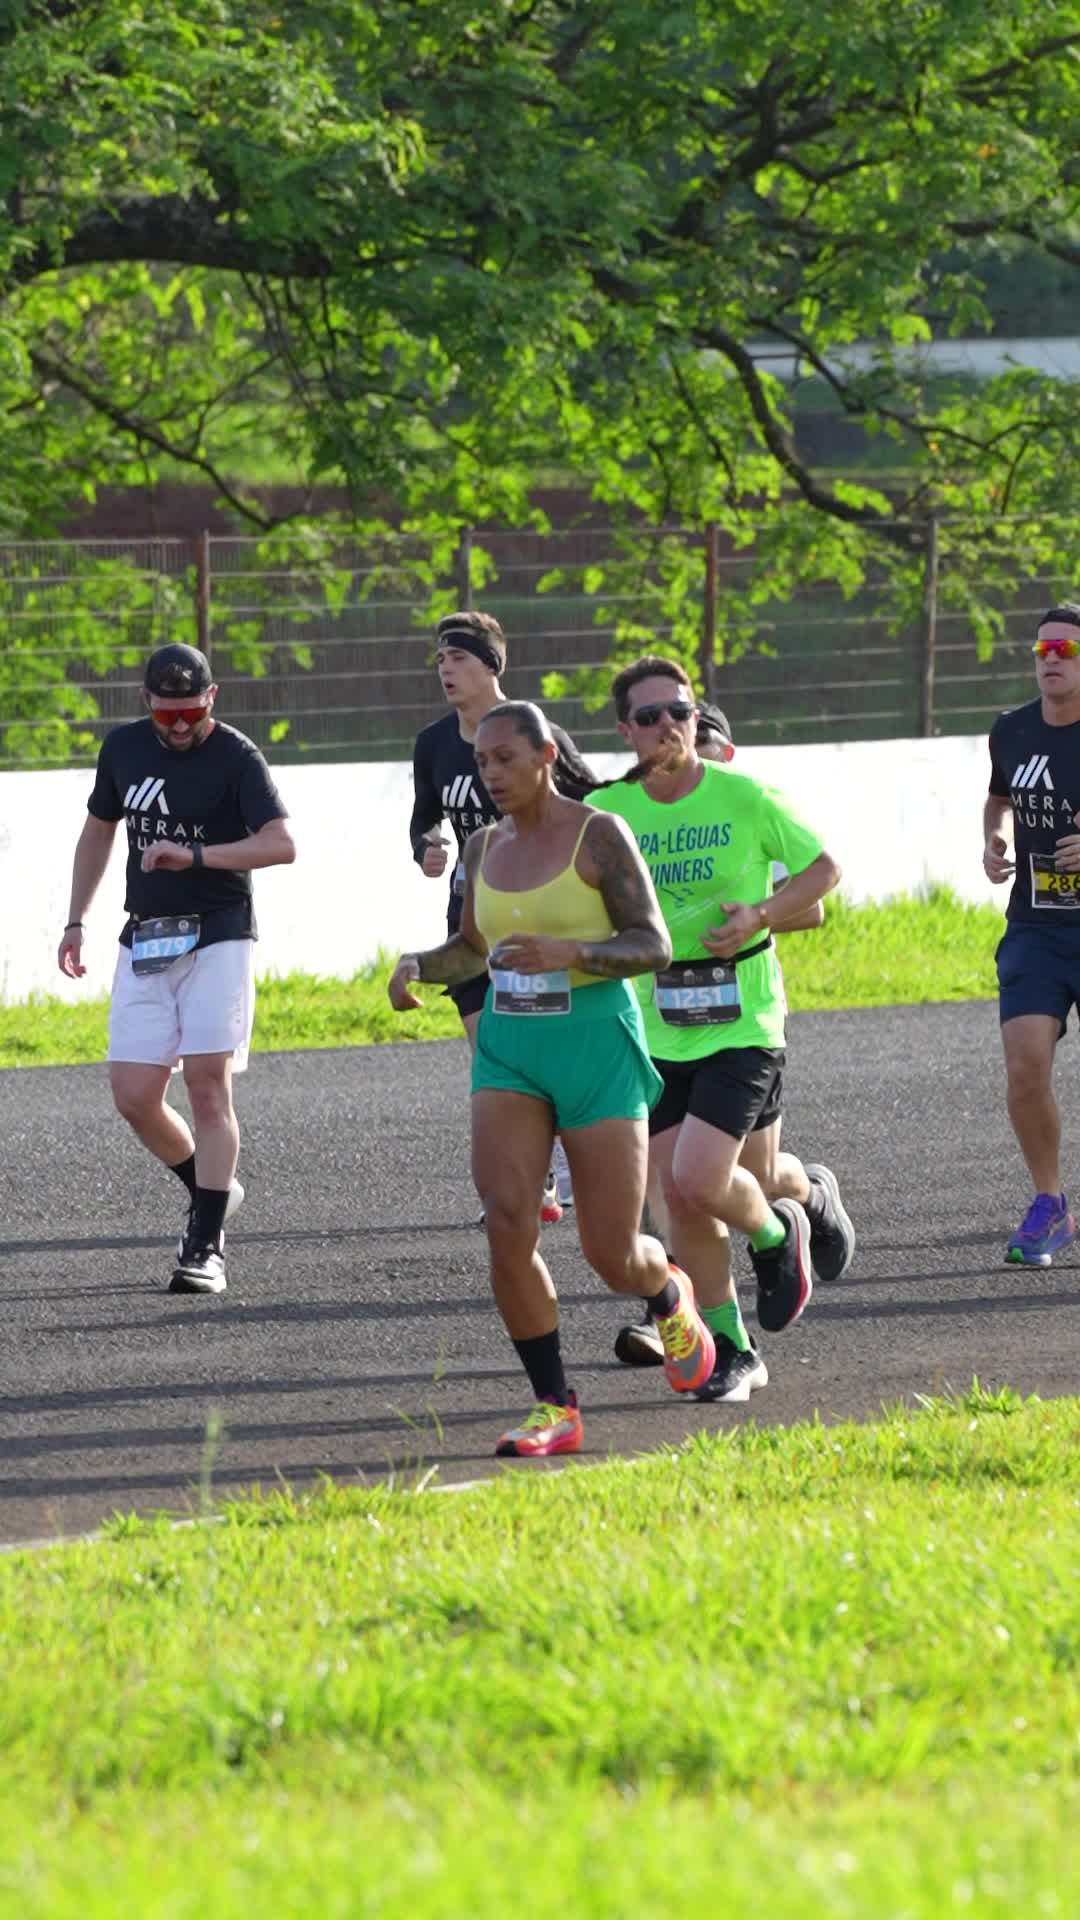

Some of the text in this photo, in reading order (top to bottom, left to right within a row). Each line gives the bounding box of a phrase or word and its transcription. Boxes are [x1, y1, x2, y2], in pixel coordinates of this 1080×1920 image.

[125, 815, 205, 839] MERAK
[636, 823, 731, 856] PA-LÉGUAS
[650, 856, 714, 887] UNNERS
[143, 936, 187, 959] 1379
[672, 985, 722, 1010] 1251
